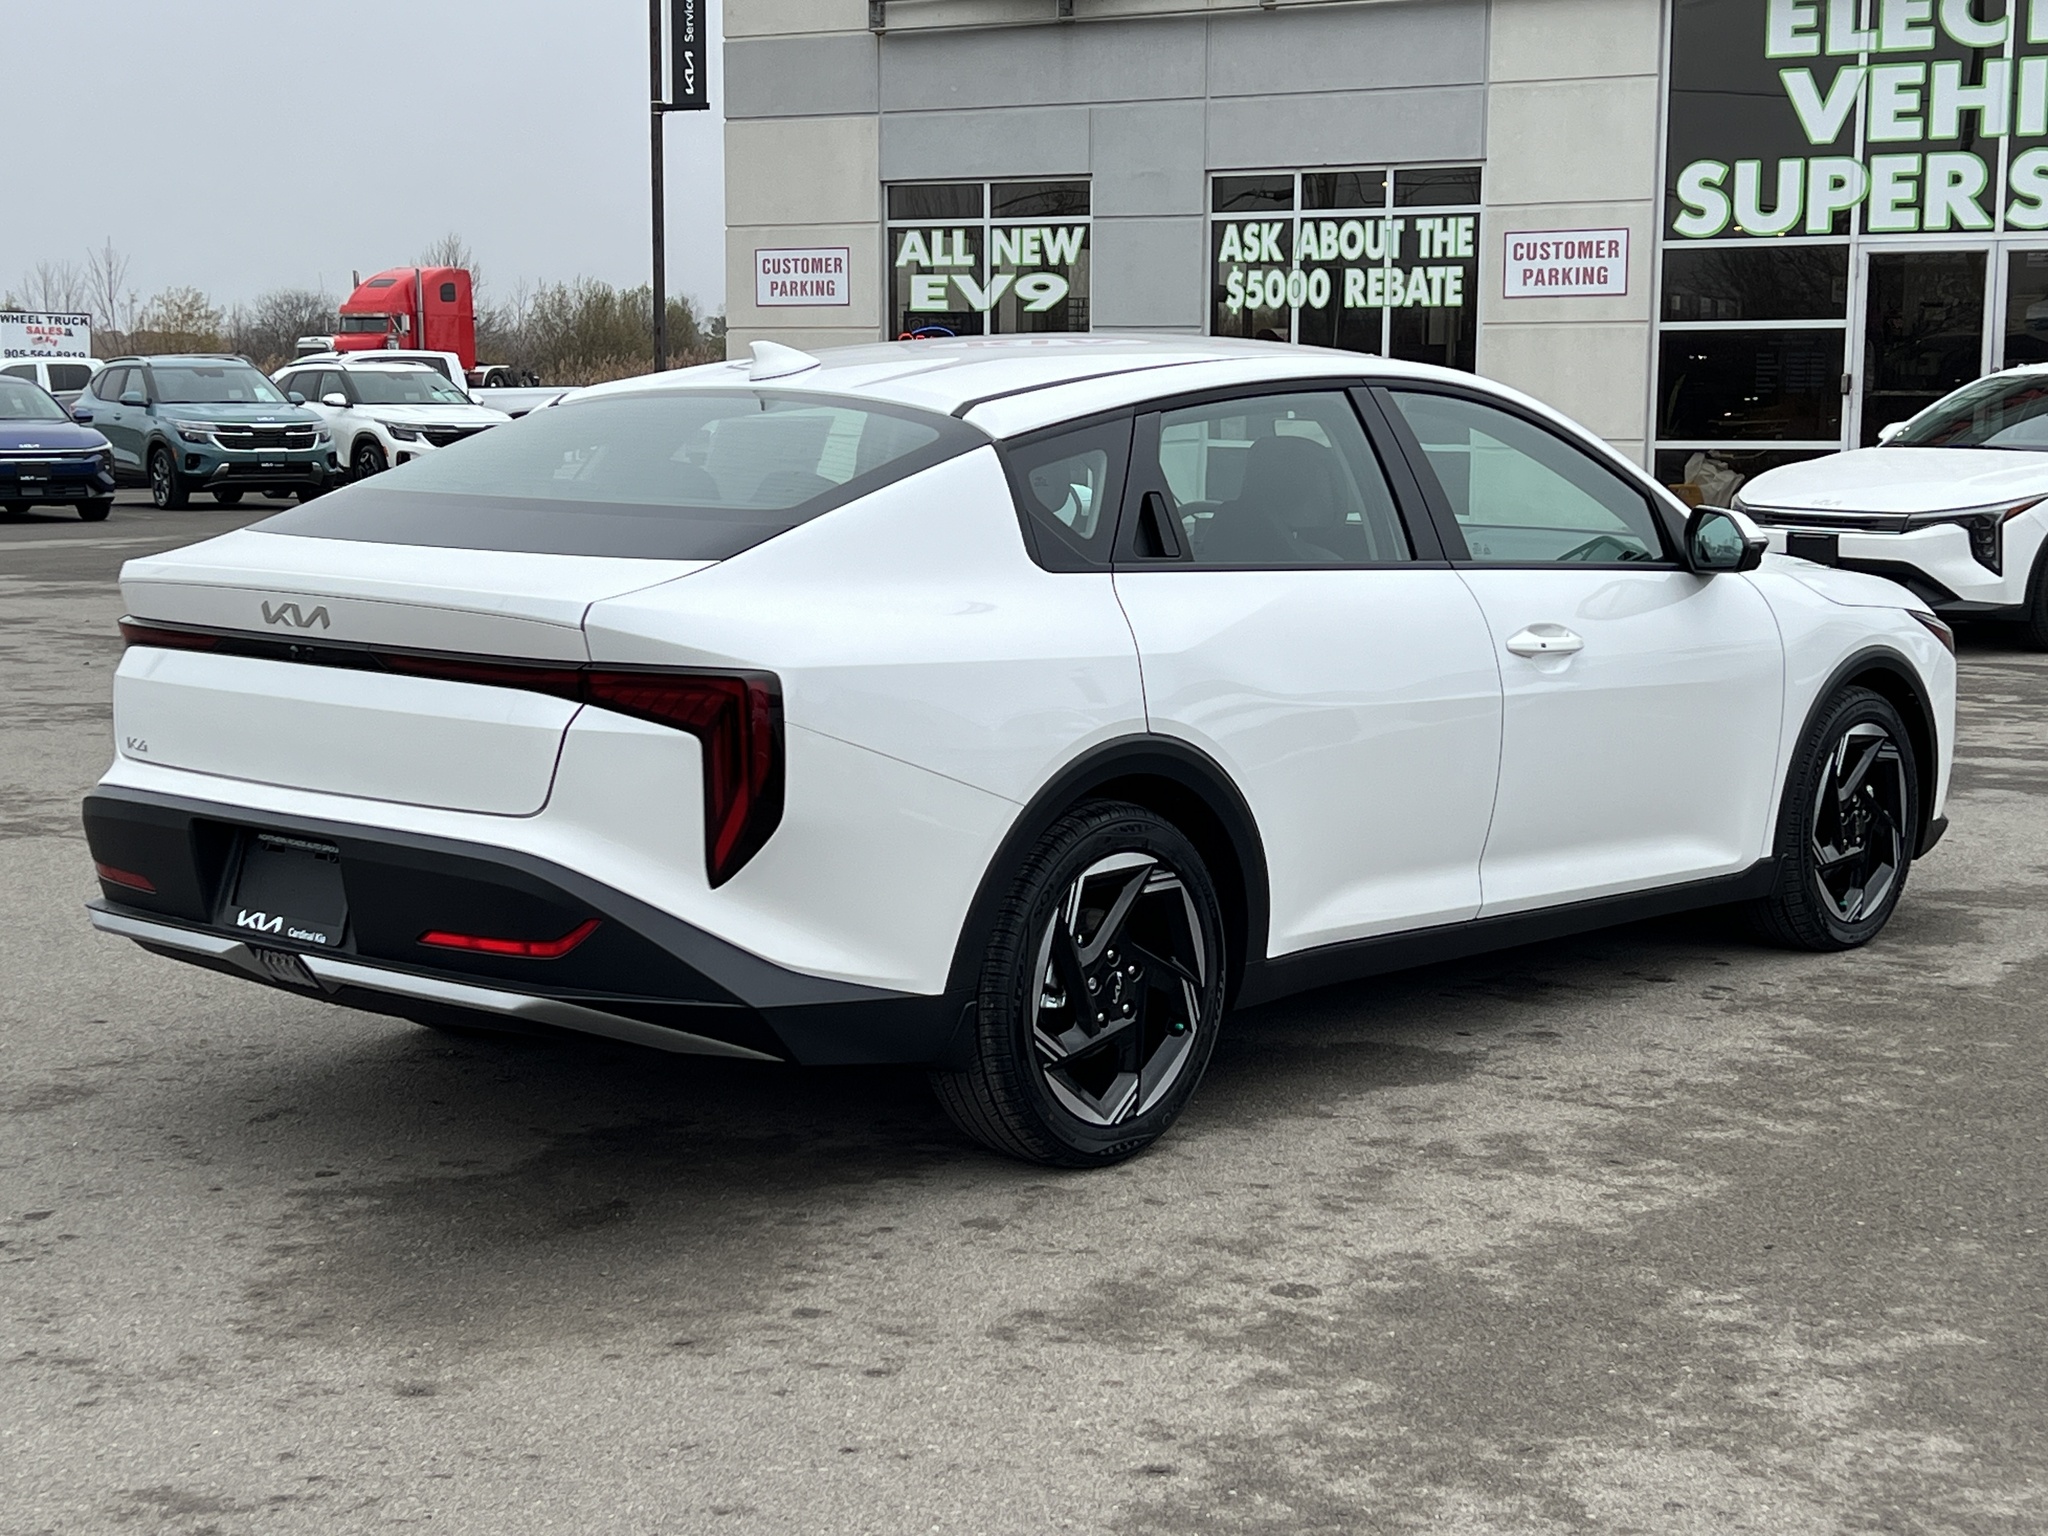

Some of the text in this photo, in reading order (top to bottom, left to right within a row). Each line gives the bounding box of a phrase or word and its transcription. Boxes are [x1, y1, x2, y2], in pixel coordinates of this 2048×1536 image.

[1764, 0, 2048, 59] ELEC
[684, 51, 694, 94] KIA
[895, 226, 1086, 267] ALL NEW
[1218, 216, 1475, 263] ASK ABOUT THE
[1512, 240, 1620, 261] CUSTOMER
[762, 257, 843, 274] CUSTOMER
[1522, 266, 1609, 286] PARKING
[770, 280, 836, 297] PARKING
[909, 272, 1069, 312] EV9
[1225, 265, 1464, 315] $5000 REBATE
[0, 314, 88, 326] WHEEL TRUCK
[26, 326, 63, 336] SALES
[261, 600, 331, 630] KIA
[126, 737, 148, 752] K4
[237, 909, 284, 934] KIA
[314, 933, 327, 944] Kia
